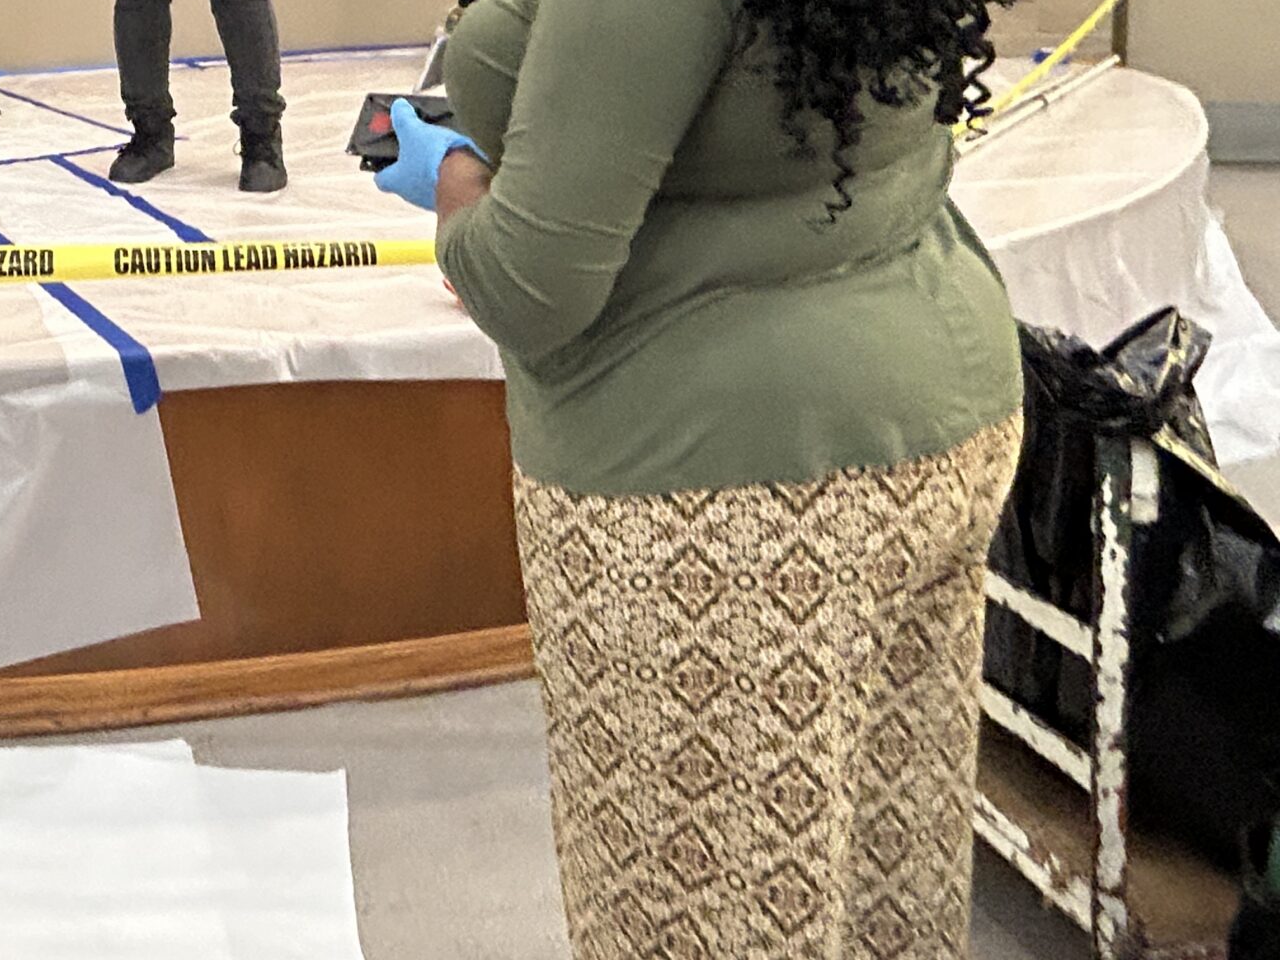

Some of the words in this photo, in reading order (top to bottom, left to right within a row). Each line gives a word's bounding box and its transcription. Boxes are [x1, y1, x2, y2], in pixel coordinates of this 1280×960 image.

[114, 246, 216, 275] CAUTION
[222, 244, 277, 272] LEAD
[283, 241, 377, 269] HAZARD
